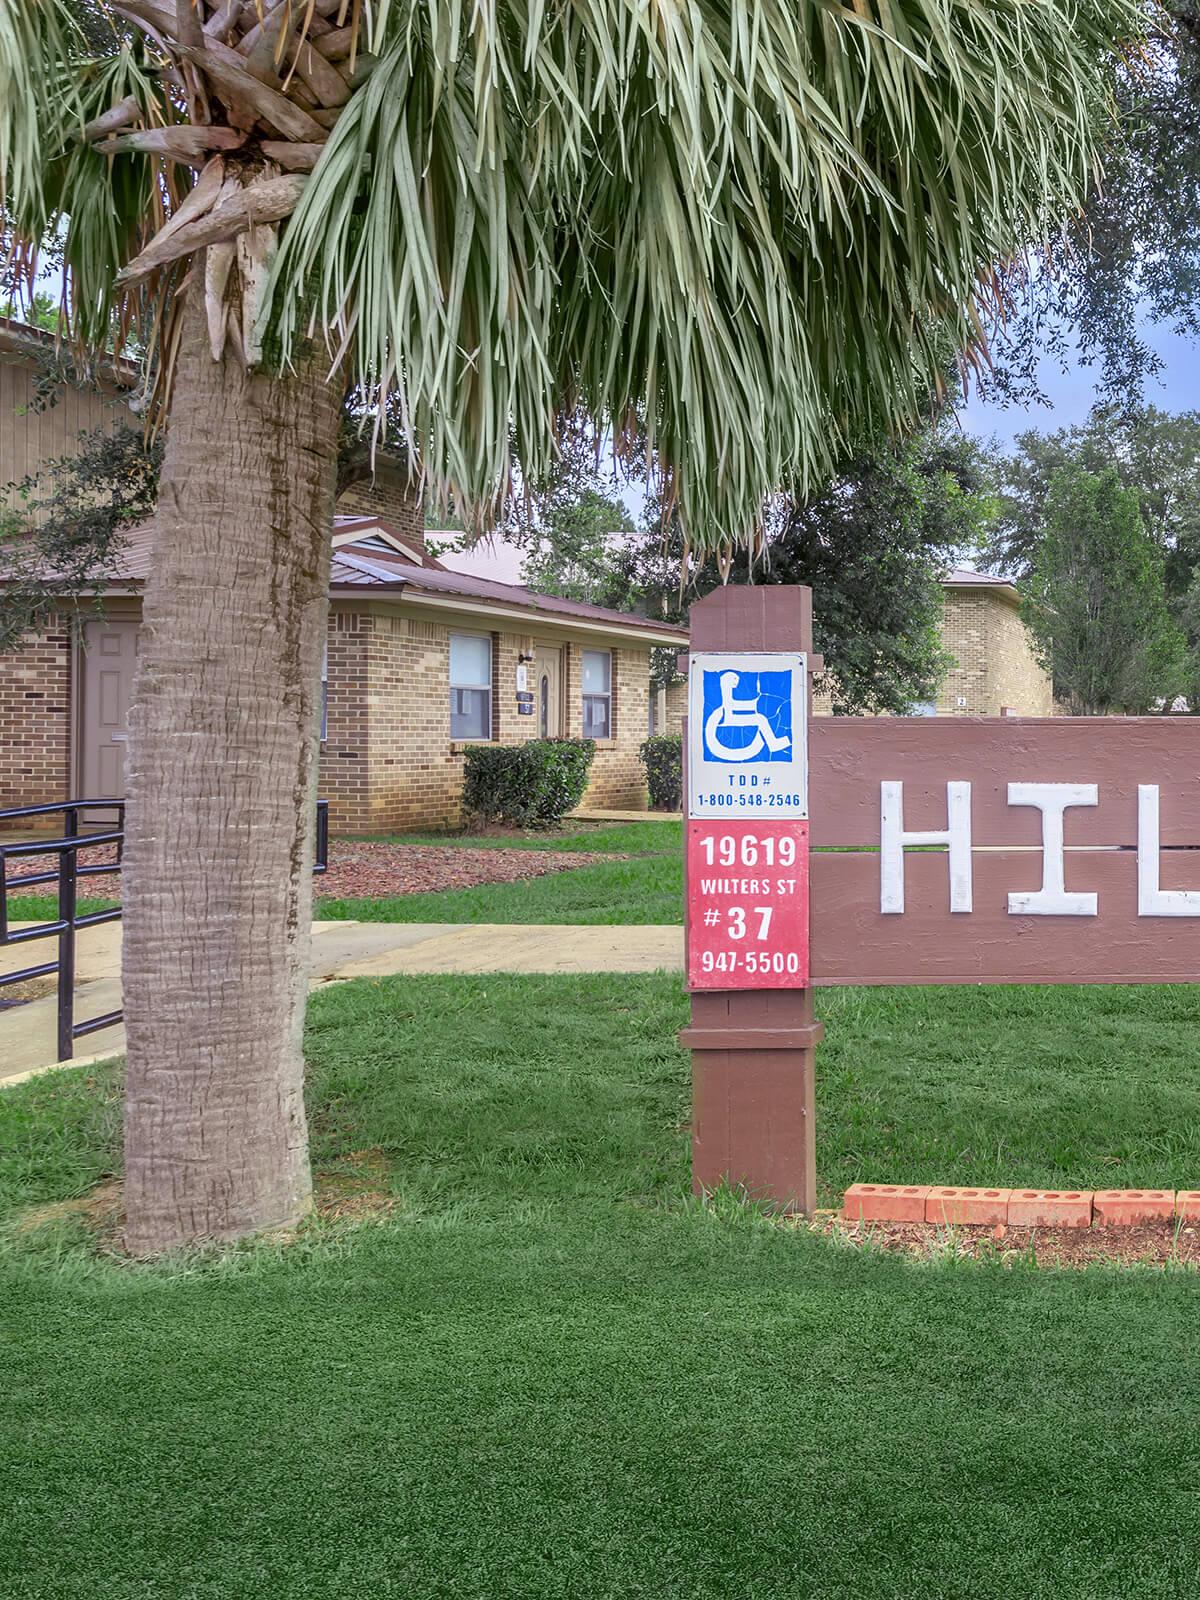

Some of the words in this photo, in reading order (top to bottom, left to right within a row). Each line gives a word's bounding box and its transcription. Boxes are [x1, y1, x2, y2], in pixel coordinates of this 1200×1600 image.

[698, 794, 800, 806] 1-800-548-2546
[700, 834, 796, 867] 19619
[701, 878, 770, 895] WILTERS
[777, 879, 796, 895] ST
[702, 951, 799, 974] 947-5500
